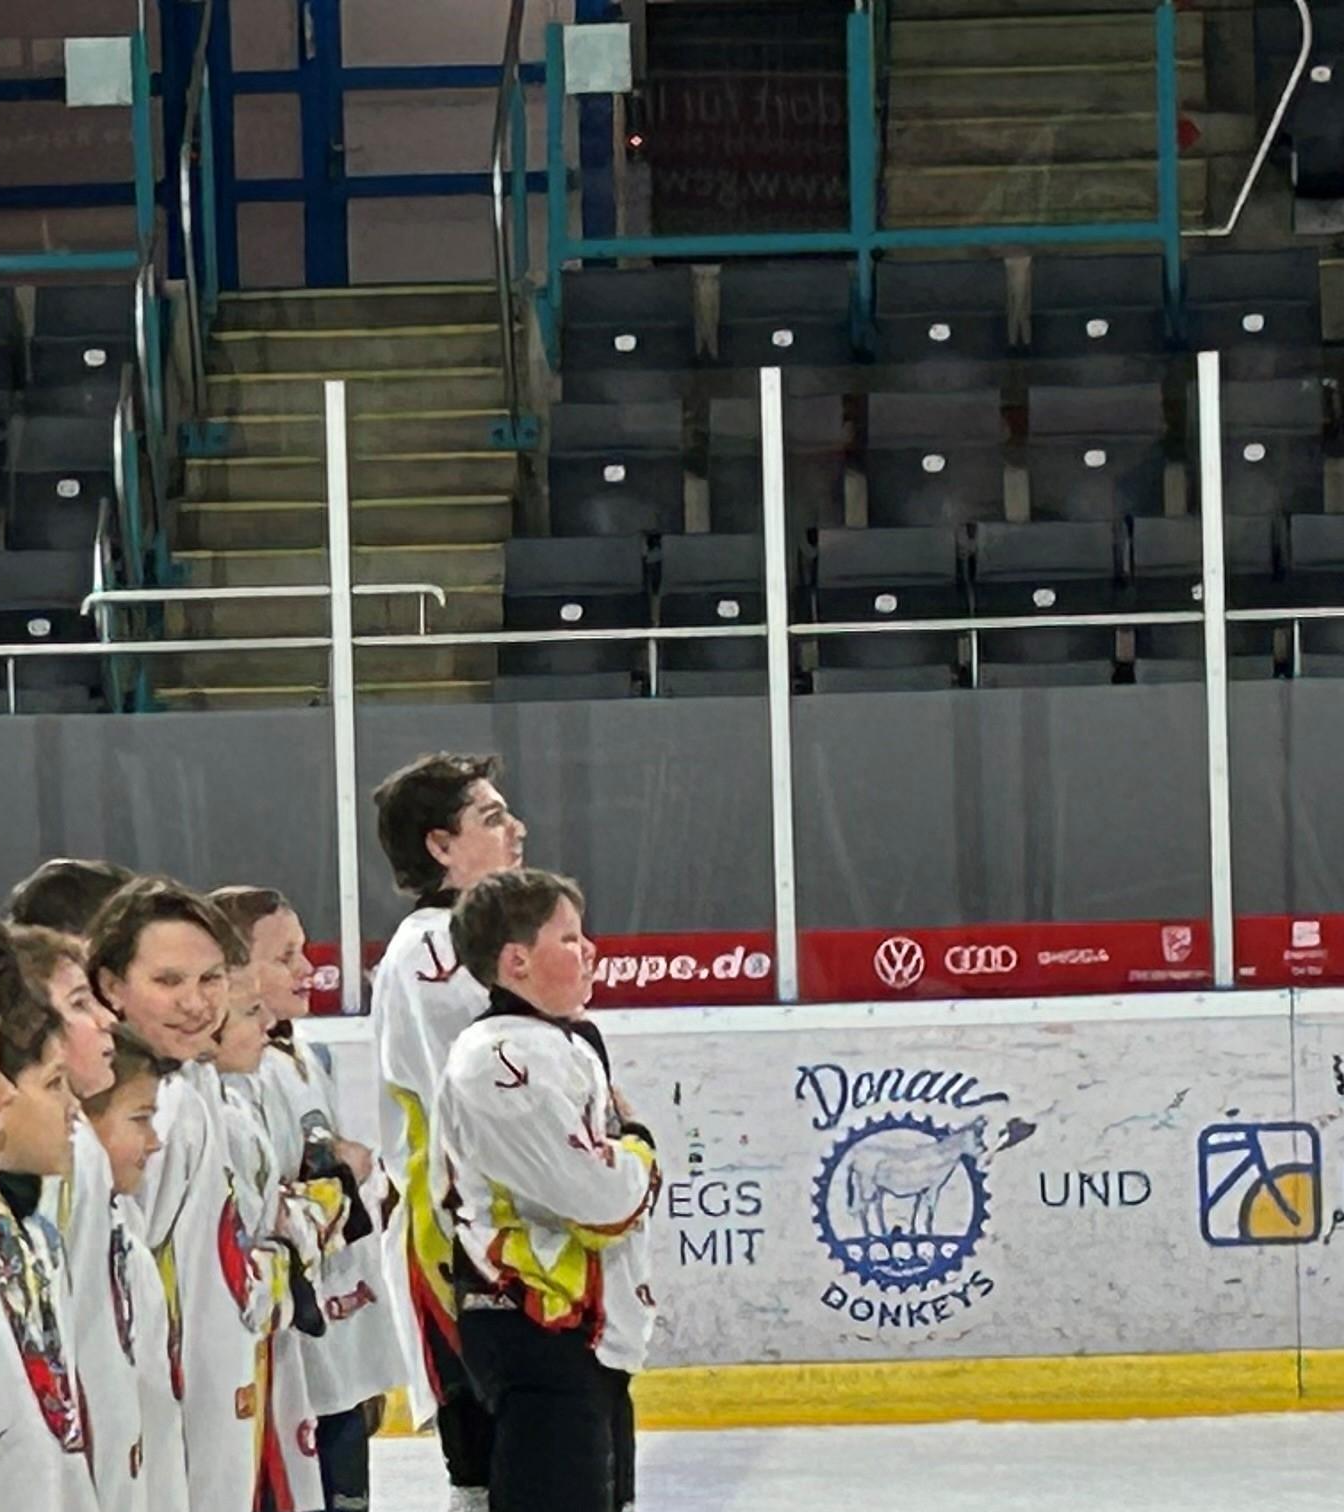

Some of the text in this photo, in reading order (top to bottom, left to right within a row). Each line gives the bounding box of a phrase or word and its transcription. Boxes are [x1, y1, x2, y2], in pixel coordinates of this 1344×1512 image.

[795, 1063, 1010, 1130] Donau
[1038, 1169, 1152, 1207] UND
[679, 1227, 766, 1267] MIT
[820, 1270, 995, 1328] DONKEYS
